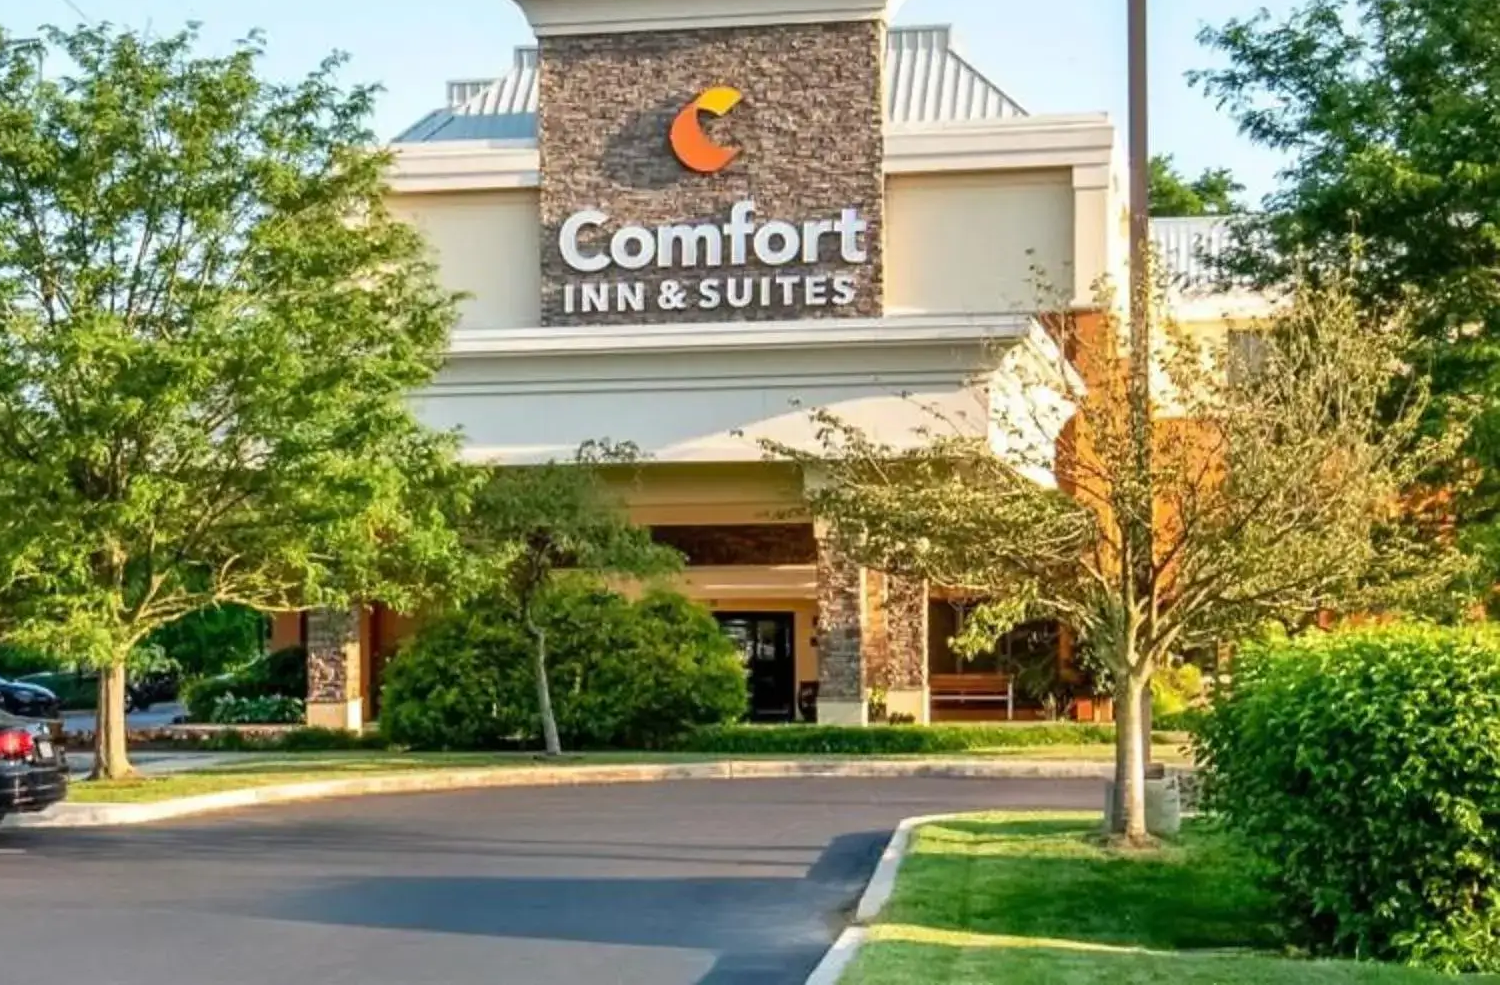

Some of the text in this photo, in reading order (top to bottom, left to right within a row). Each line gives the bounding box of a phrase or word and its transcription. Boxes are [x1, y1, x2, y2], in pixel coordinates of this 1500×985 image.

[558, 199, 868, 273] Comfort
[564, 273, 857, 314] INN & SUITES
